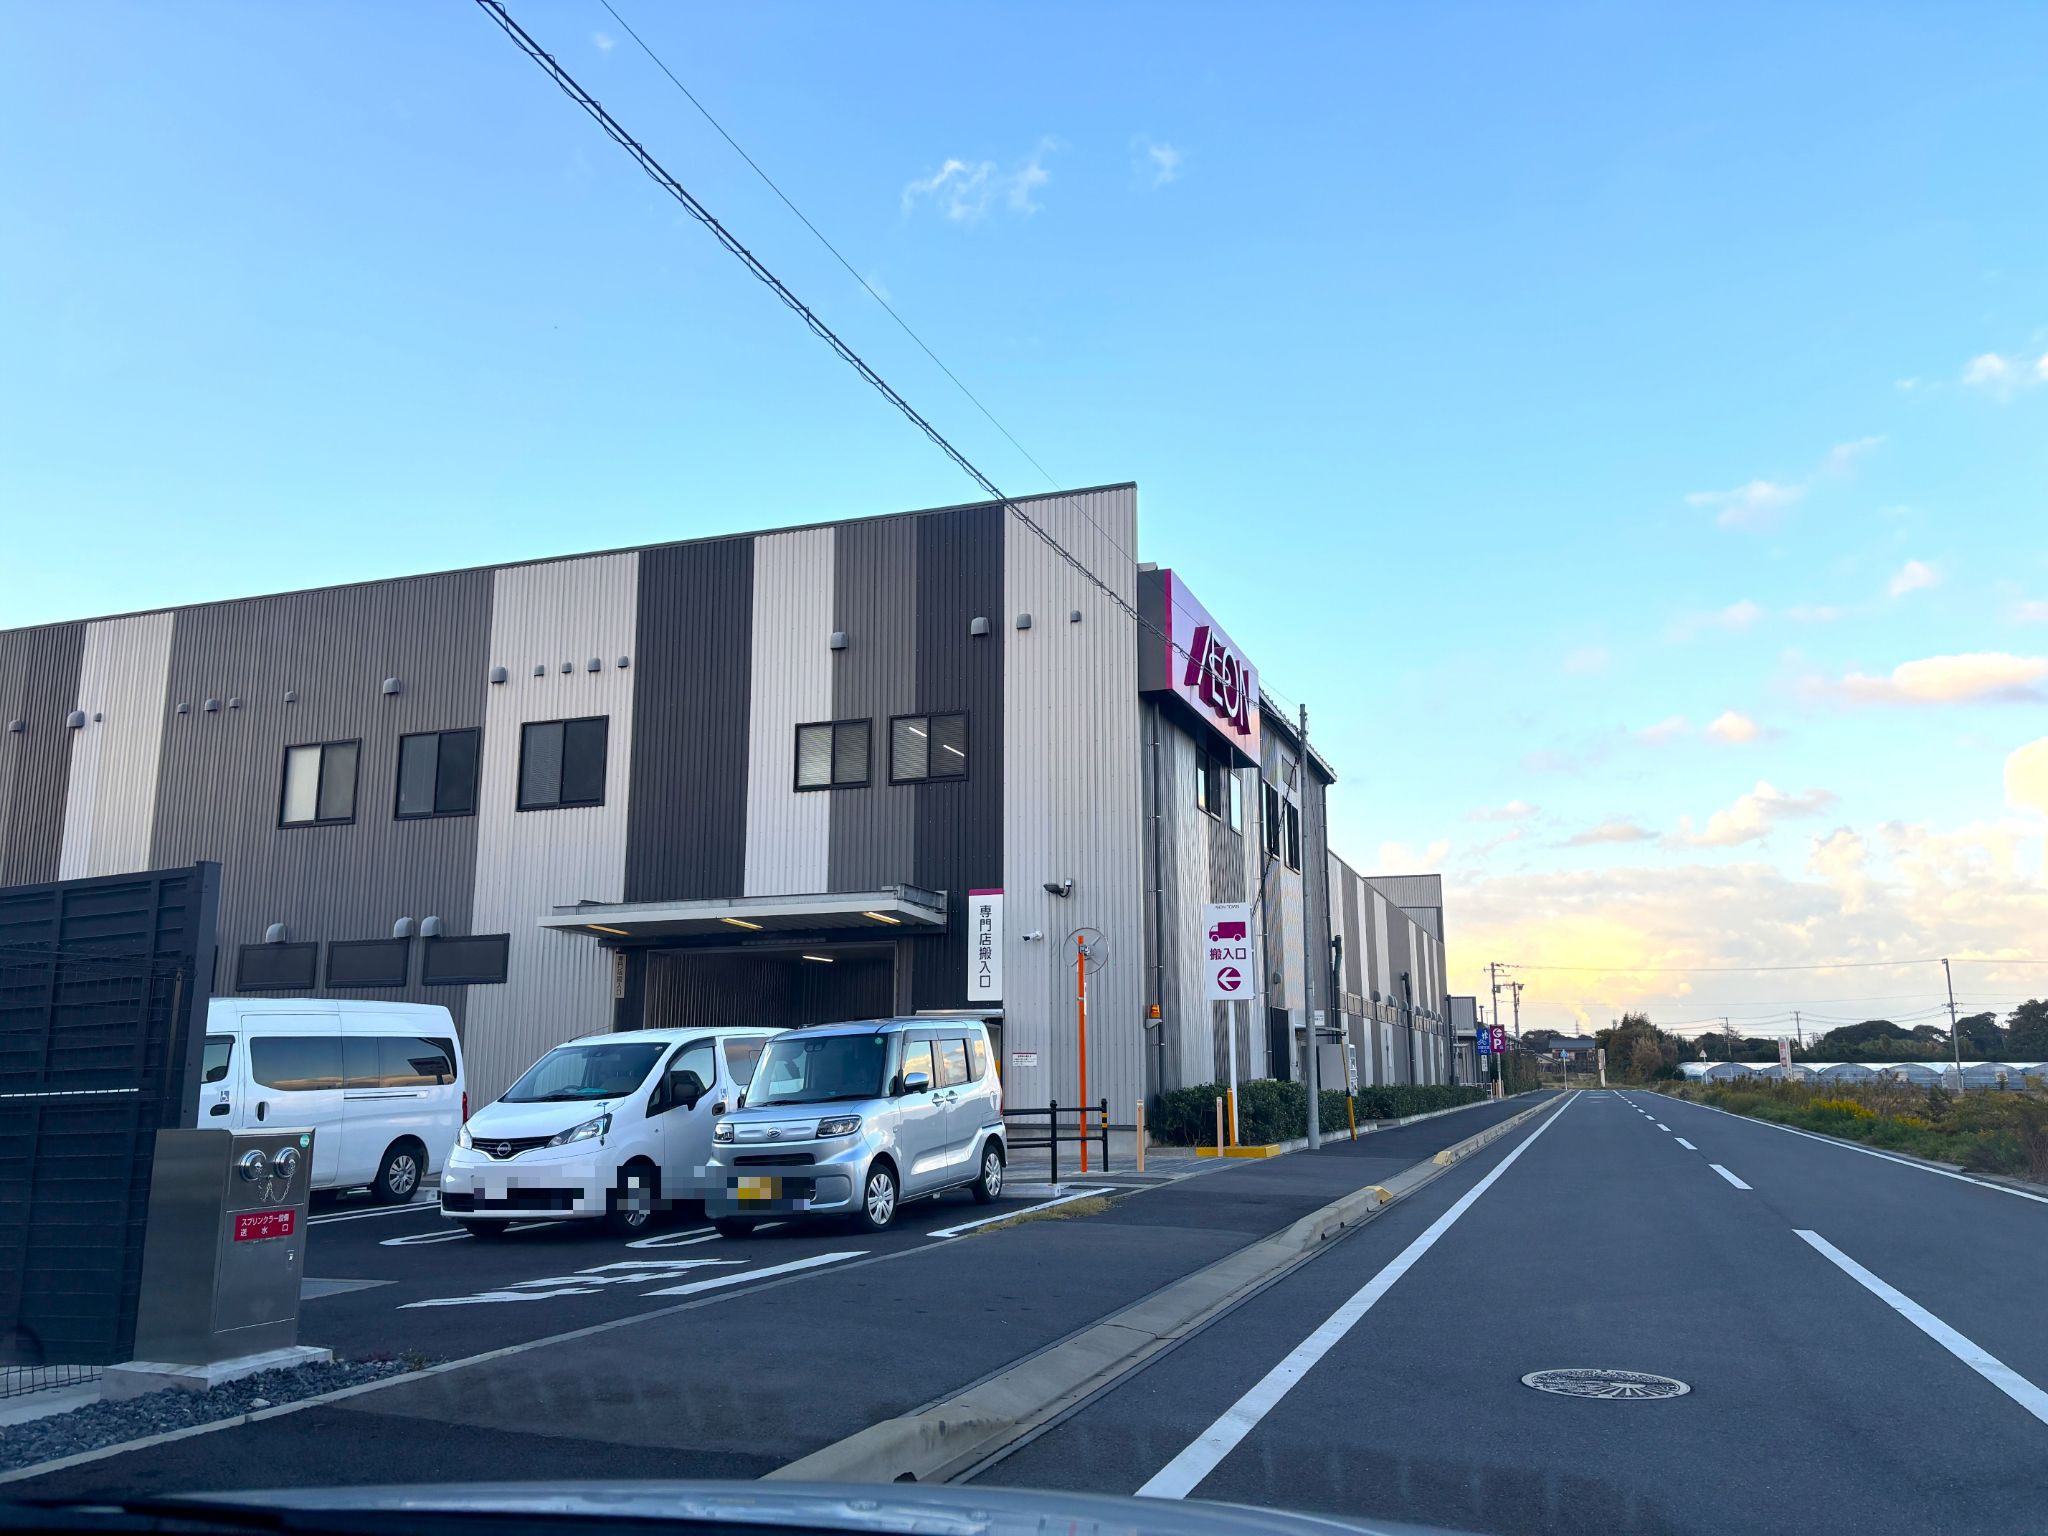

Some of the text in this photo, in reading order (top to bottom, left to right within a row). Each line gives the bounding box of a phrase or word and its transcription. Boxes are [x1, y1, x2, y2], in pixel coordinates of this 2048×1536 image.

[980, 905, 992, 988] 専門店搬入口
[1210, 948, 1246, 960] 搬入口
[1494, 1039, 1502, 1049] P
[242, 1214, 289, 1226] スプリンクラー設備
